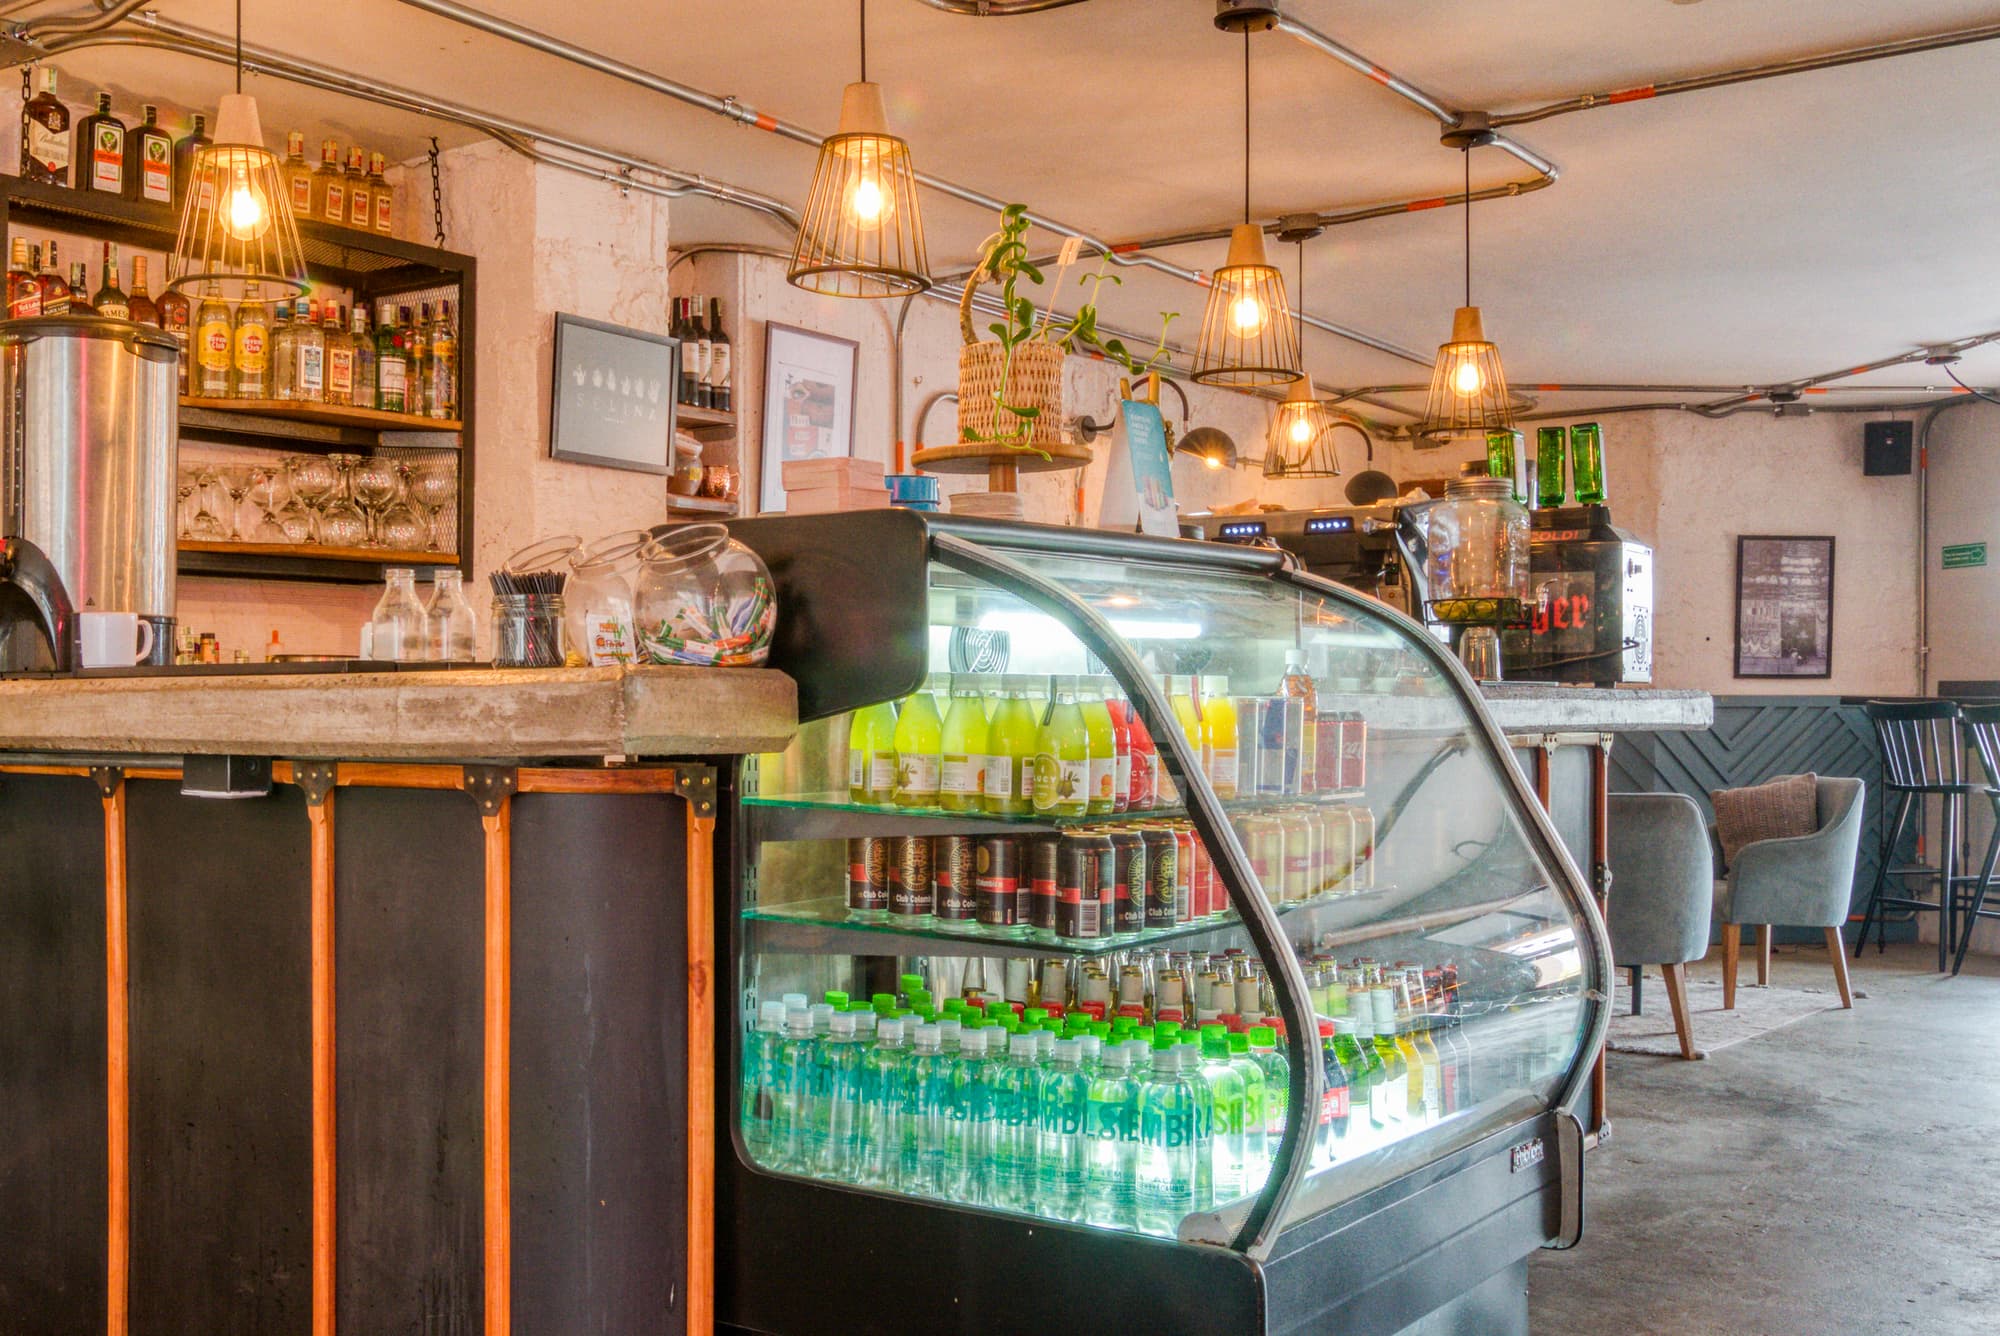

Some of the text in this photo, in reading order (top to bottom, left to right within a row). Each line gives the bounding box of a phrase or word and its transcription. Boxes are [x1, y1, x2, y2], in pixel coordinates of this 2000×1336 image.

[863, 890, 876, 898] Club
[896, 893, 909, 903] Club
[947, 899, 961, 908] Club
[1148, 907, 1163, 917] Club
